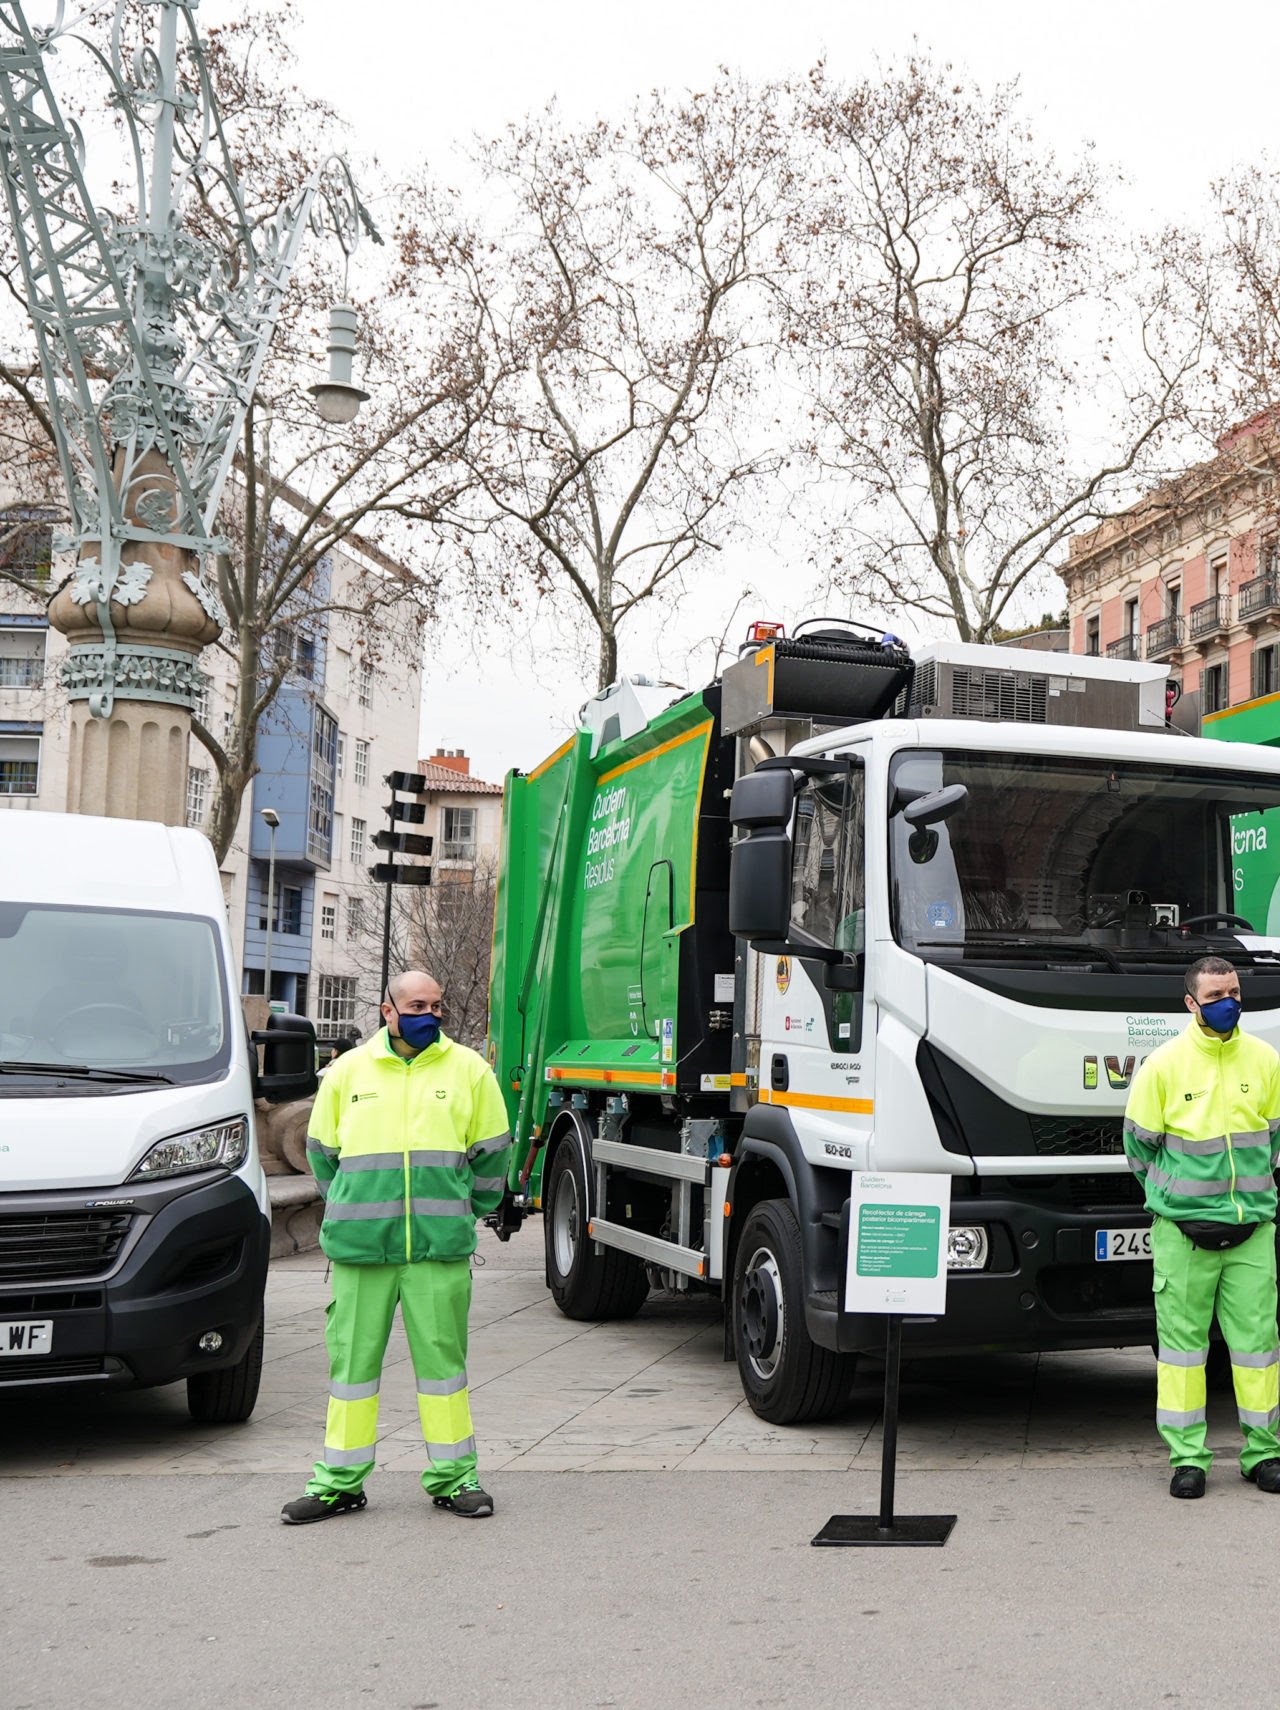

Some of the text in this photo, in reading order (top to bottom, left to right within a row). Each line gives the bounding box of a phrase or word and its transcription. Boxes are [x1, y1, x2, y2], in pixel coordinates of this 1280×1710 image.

[592, 786, 626, 821] Cuidem
[587, 817, 630, 856] Barcelona
[584, 855, 615, 890] Residus
[1126, 1015, 1166, 1026] Cuidem
[1128, 1026, 1179, 1037] Barcelona
[860, 1175, 885, 1183] Cuidem
